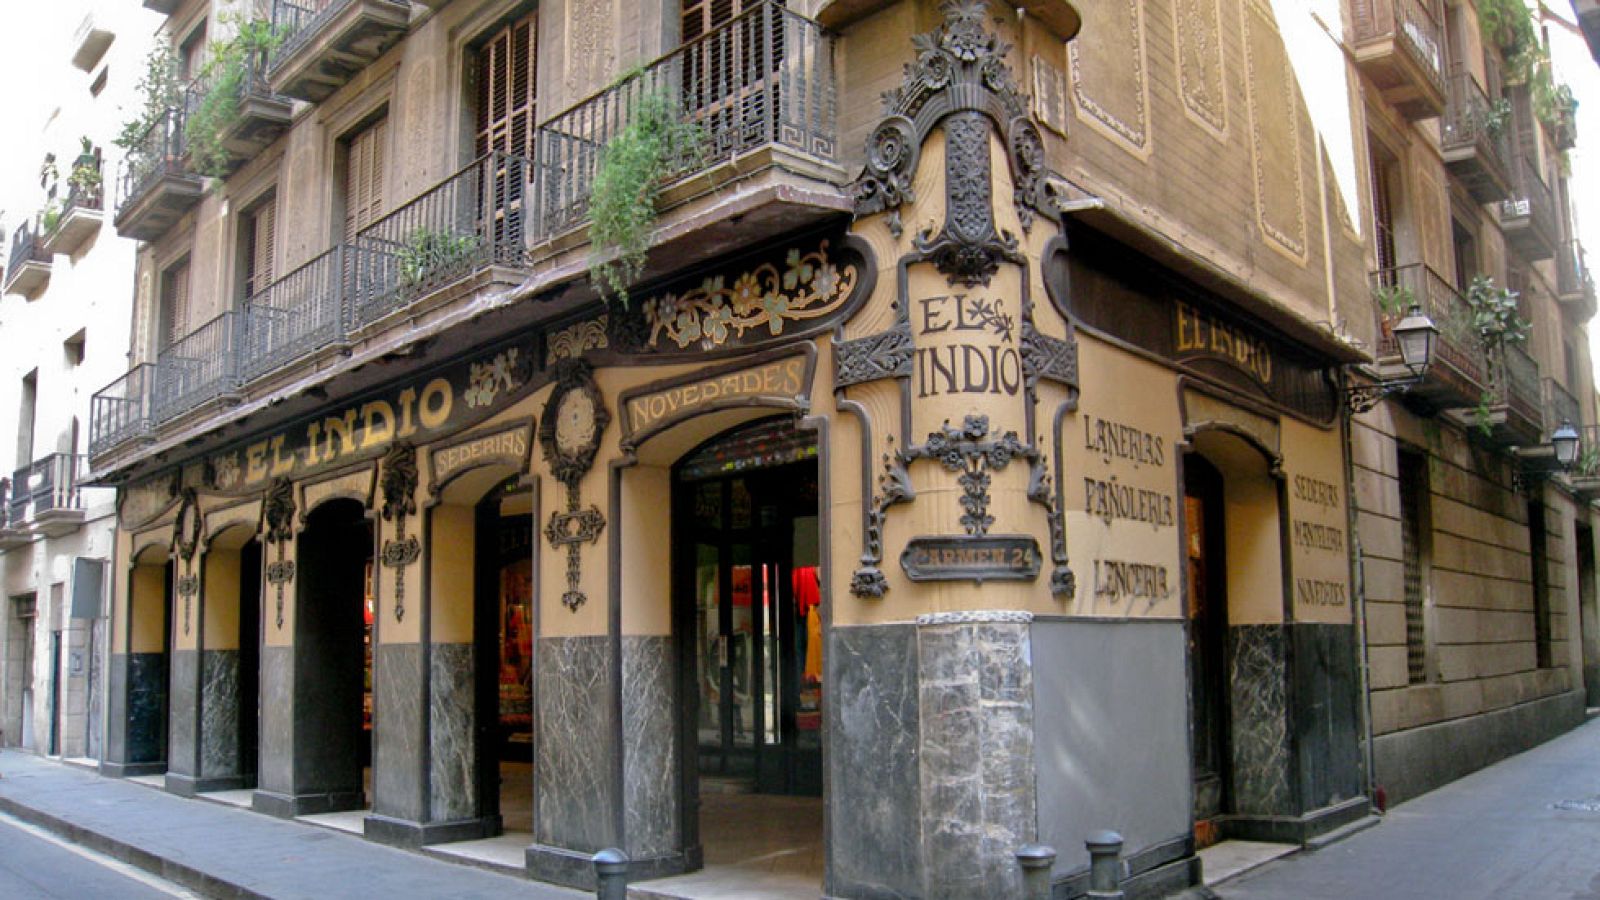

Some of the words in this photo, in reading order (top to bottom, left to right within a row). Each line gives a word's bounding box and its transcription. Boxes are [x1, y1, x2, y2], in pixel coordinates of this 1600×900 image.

[918, 294, 987, 335] EL
[1176, 299, 1206, 351] EL
[1209, 316, 1272, 385] INDIO
[631, 360, 803, 432] NOVEDADES
[916, 344, 1020, 398] INDIO
[245, 434, 295, 486] EL
[304, 378, 454, 466] INDIO
[436, 428, 526, 479] SEDERIAS
[1083, 414, 1165, 469] LANERIAS
[1083, 475, 1174, 532] PAÑOLERIA
[911, 547, 1006, 570] CARMEN
[1011, 548, 1034, 571] 24
[1093, 560, 1170, 603] LENCERIA
